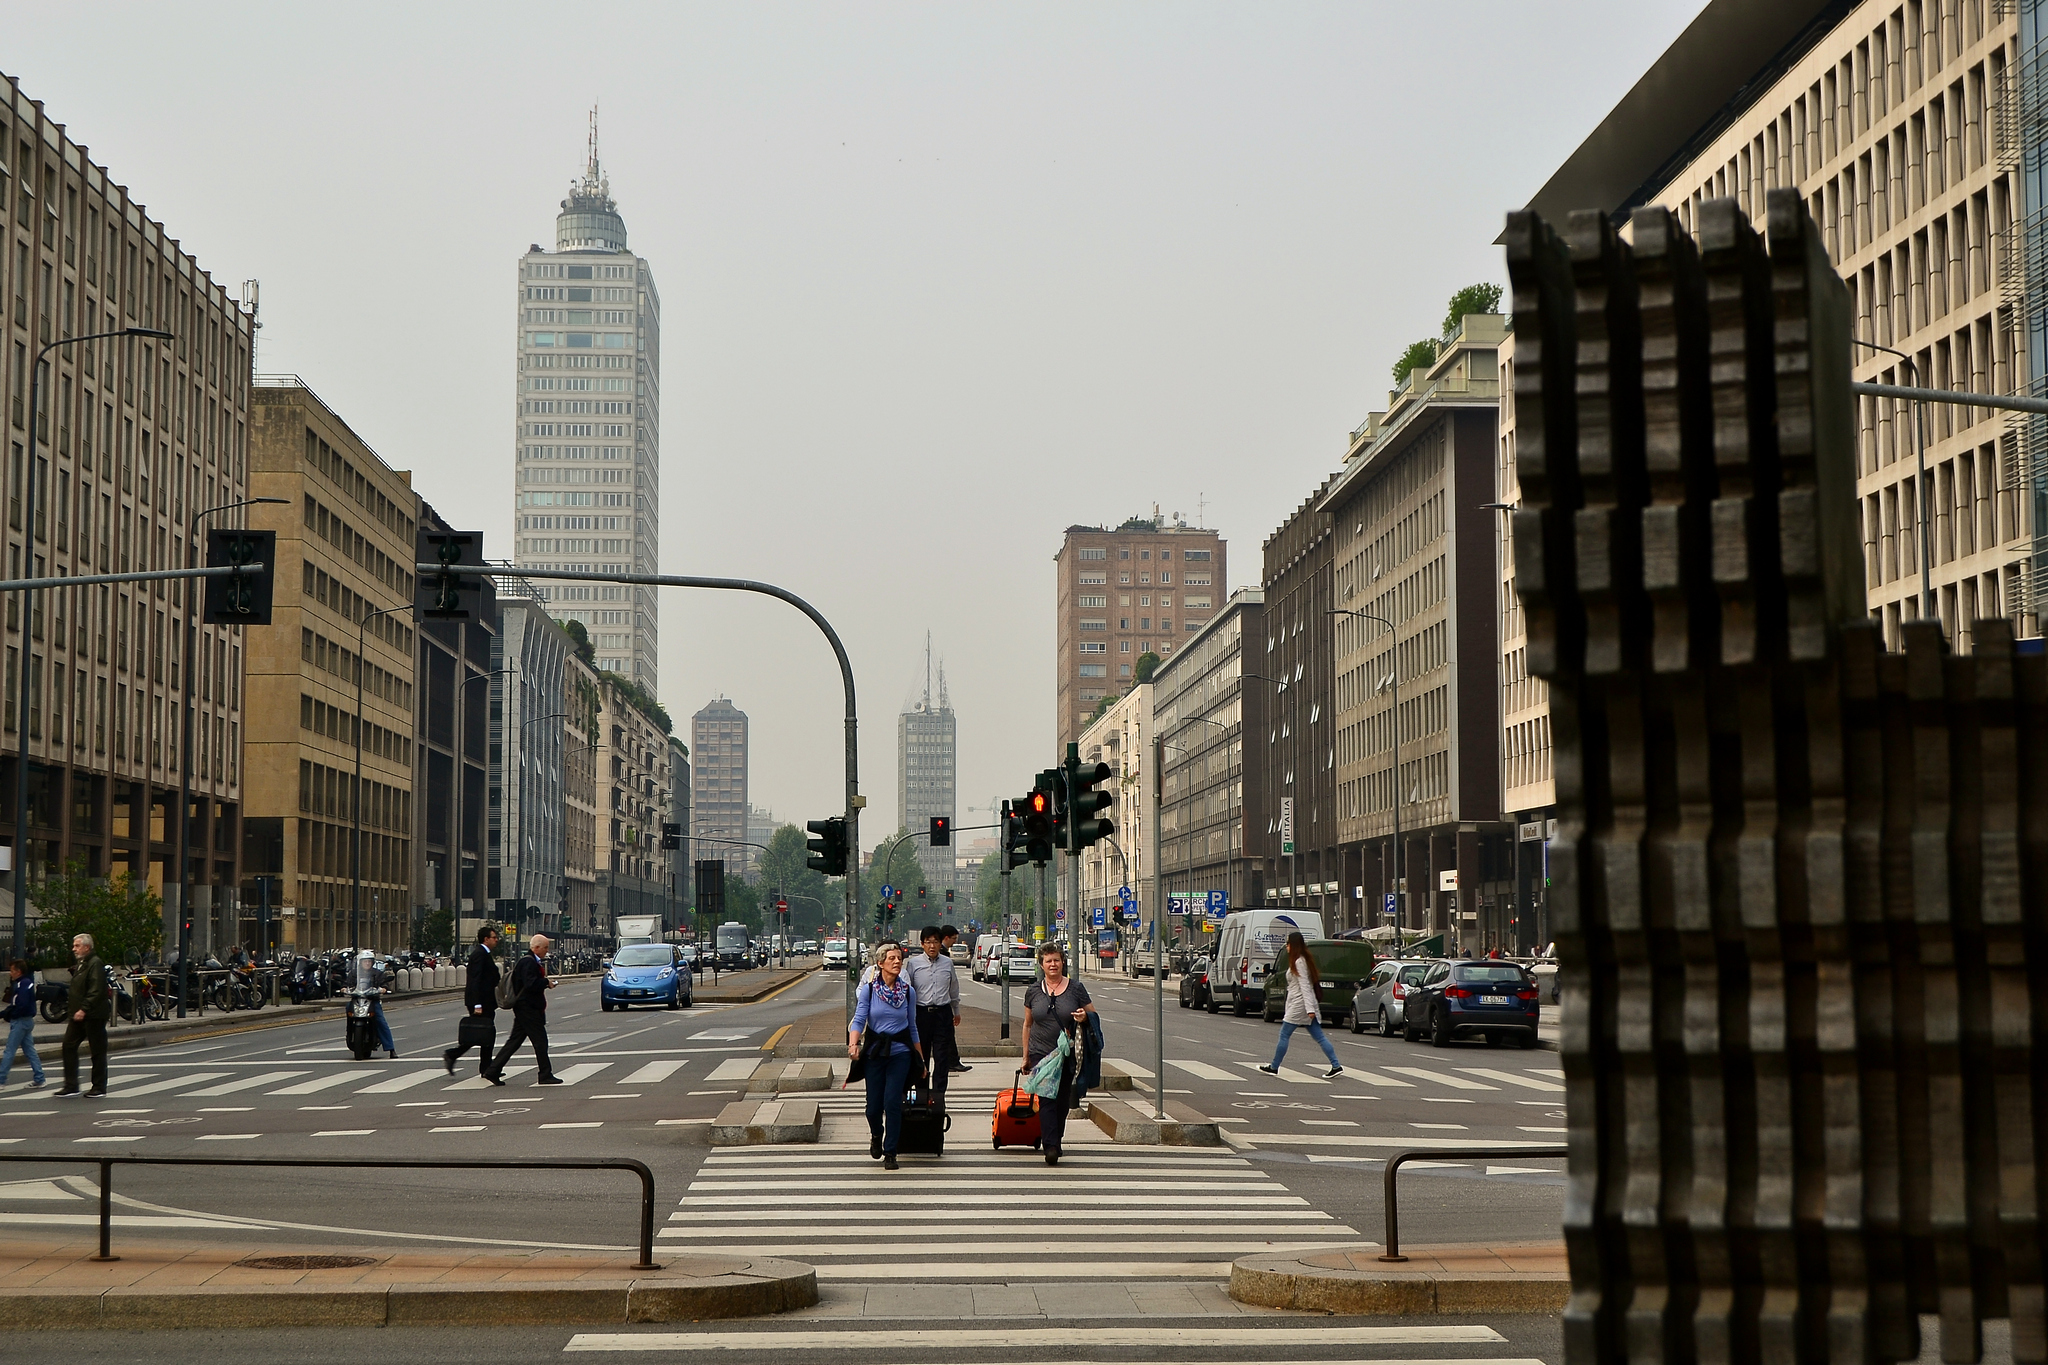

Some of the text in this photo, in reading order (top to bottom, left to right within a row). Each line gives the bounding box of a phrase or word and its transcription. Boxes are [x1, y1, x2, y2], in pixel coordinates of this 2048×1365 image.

[1211, 891, 1223, 906] P
[1387, 894, 1395, 904] P
[1095, 908, 1103, 918] P
